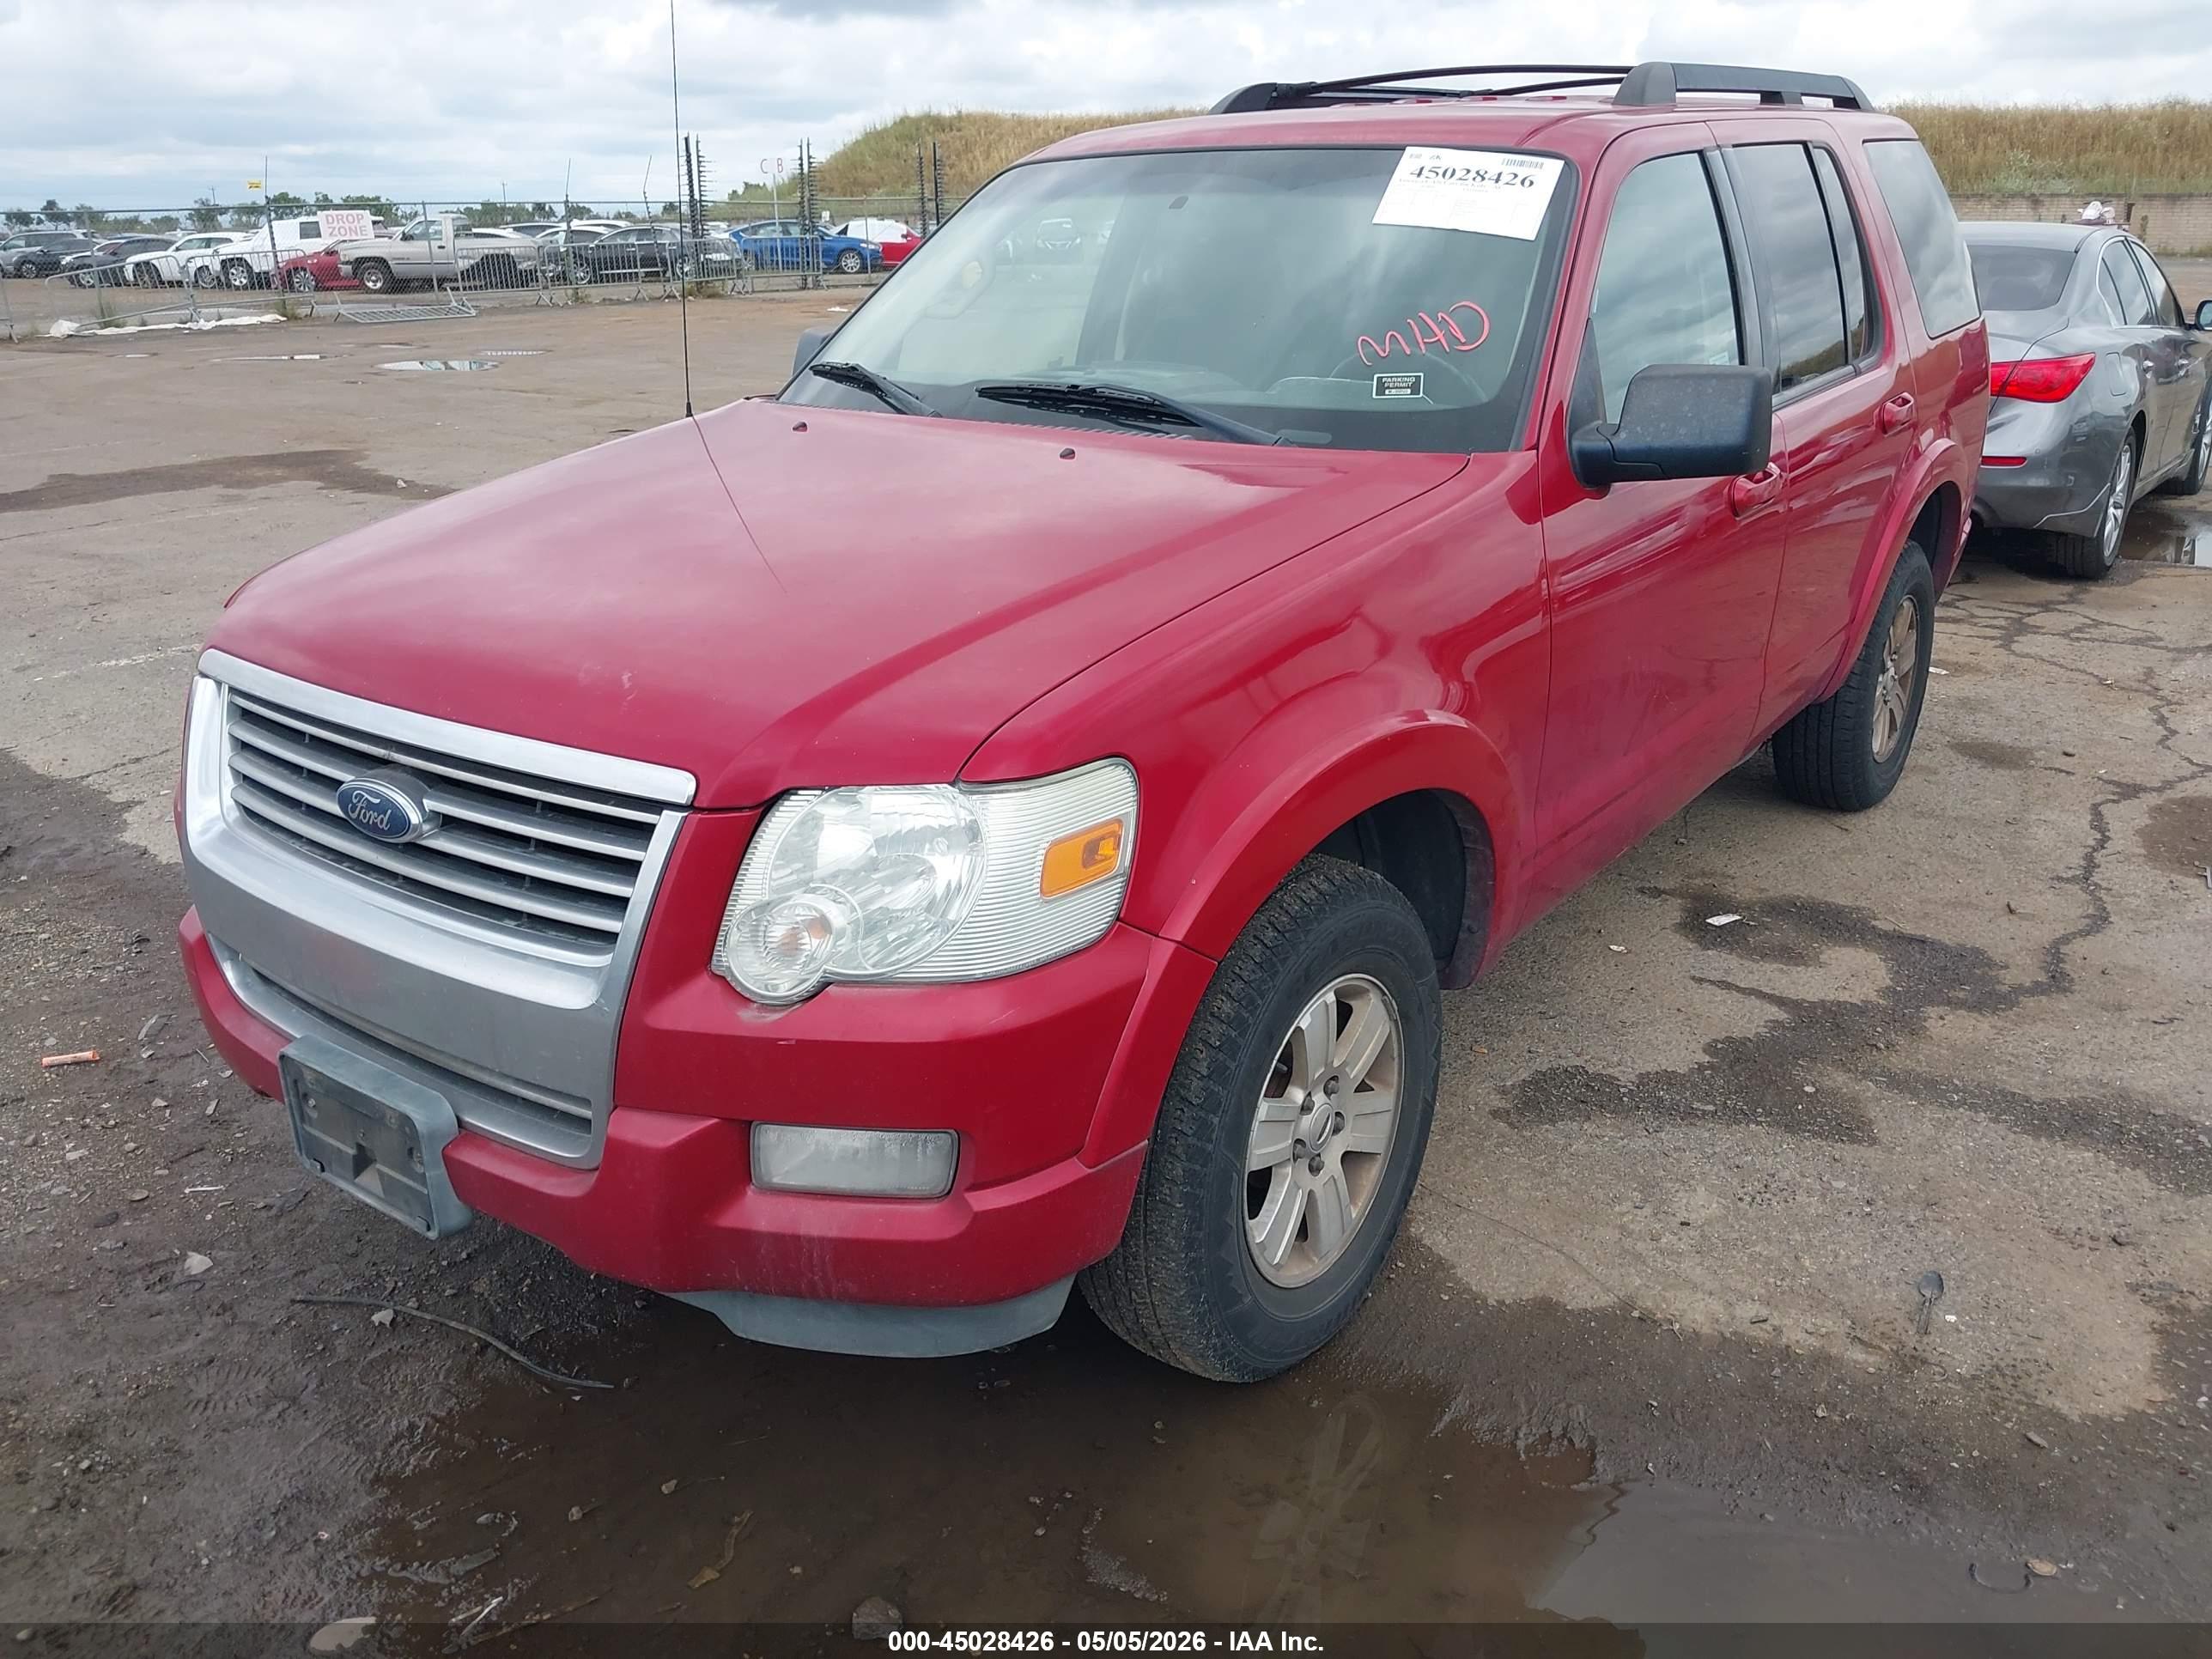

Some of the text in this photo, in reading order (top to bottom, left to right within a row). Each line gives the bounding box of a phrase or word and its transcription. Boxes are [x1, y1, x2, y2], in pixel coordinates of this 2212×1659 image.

[760, 157, 784, 174] C B
[1408, 164, 1535, 190] 45028426
[325, 213, 365, 225] DROP
[327, 226, 368, 238] ZONE
[348, 790, 392, 830] Ford
